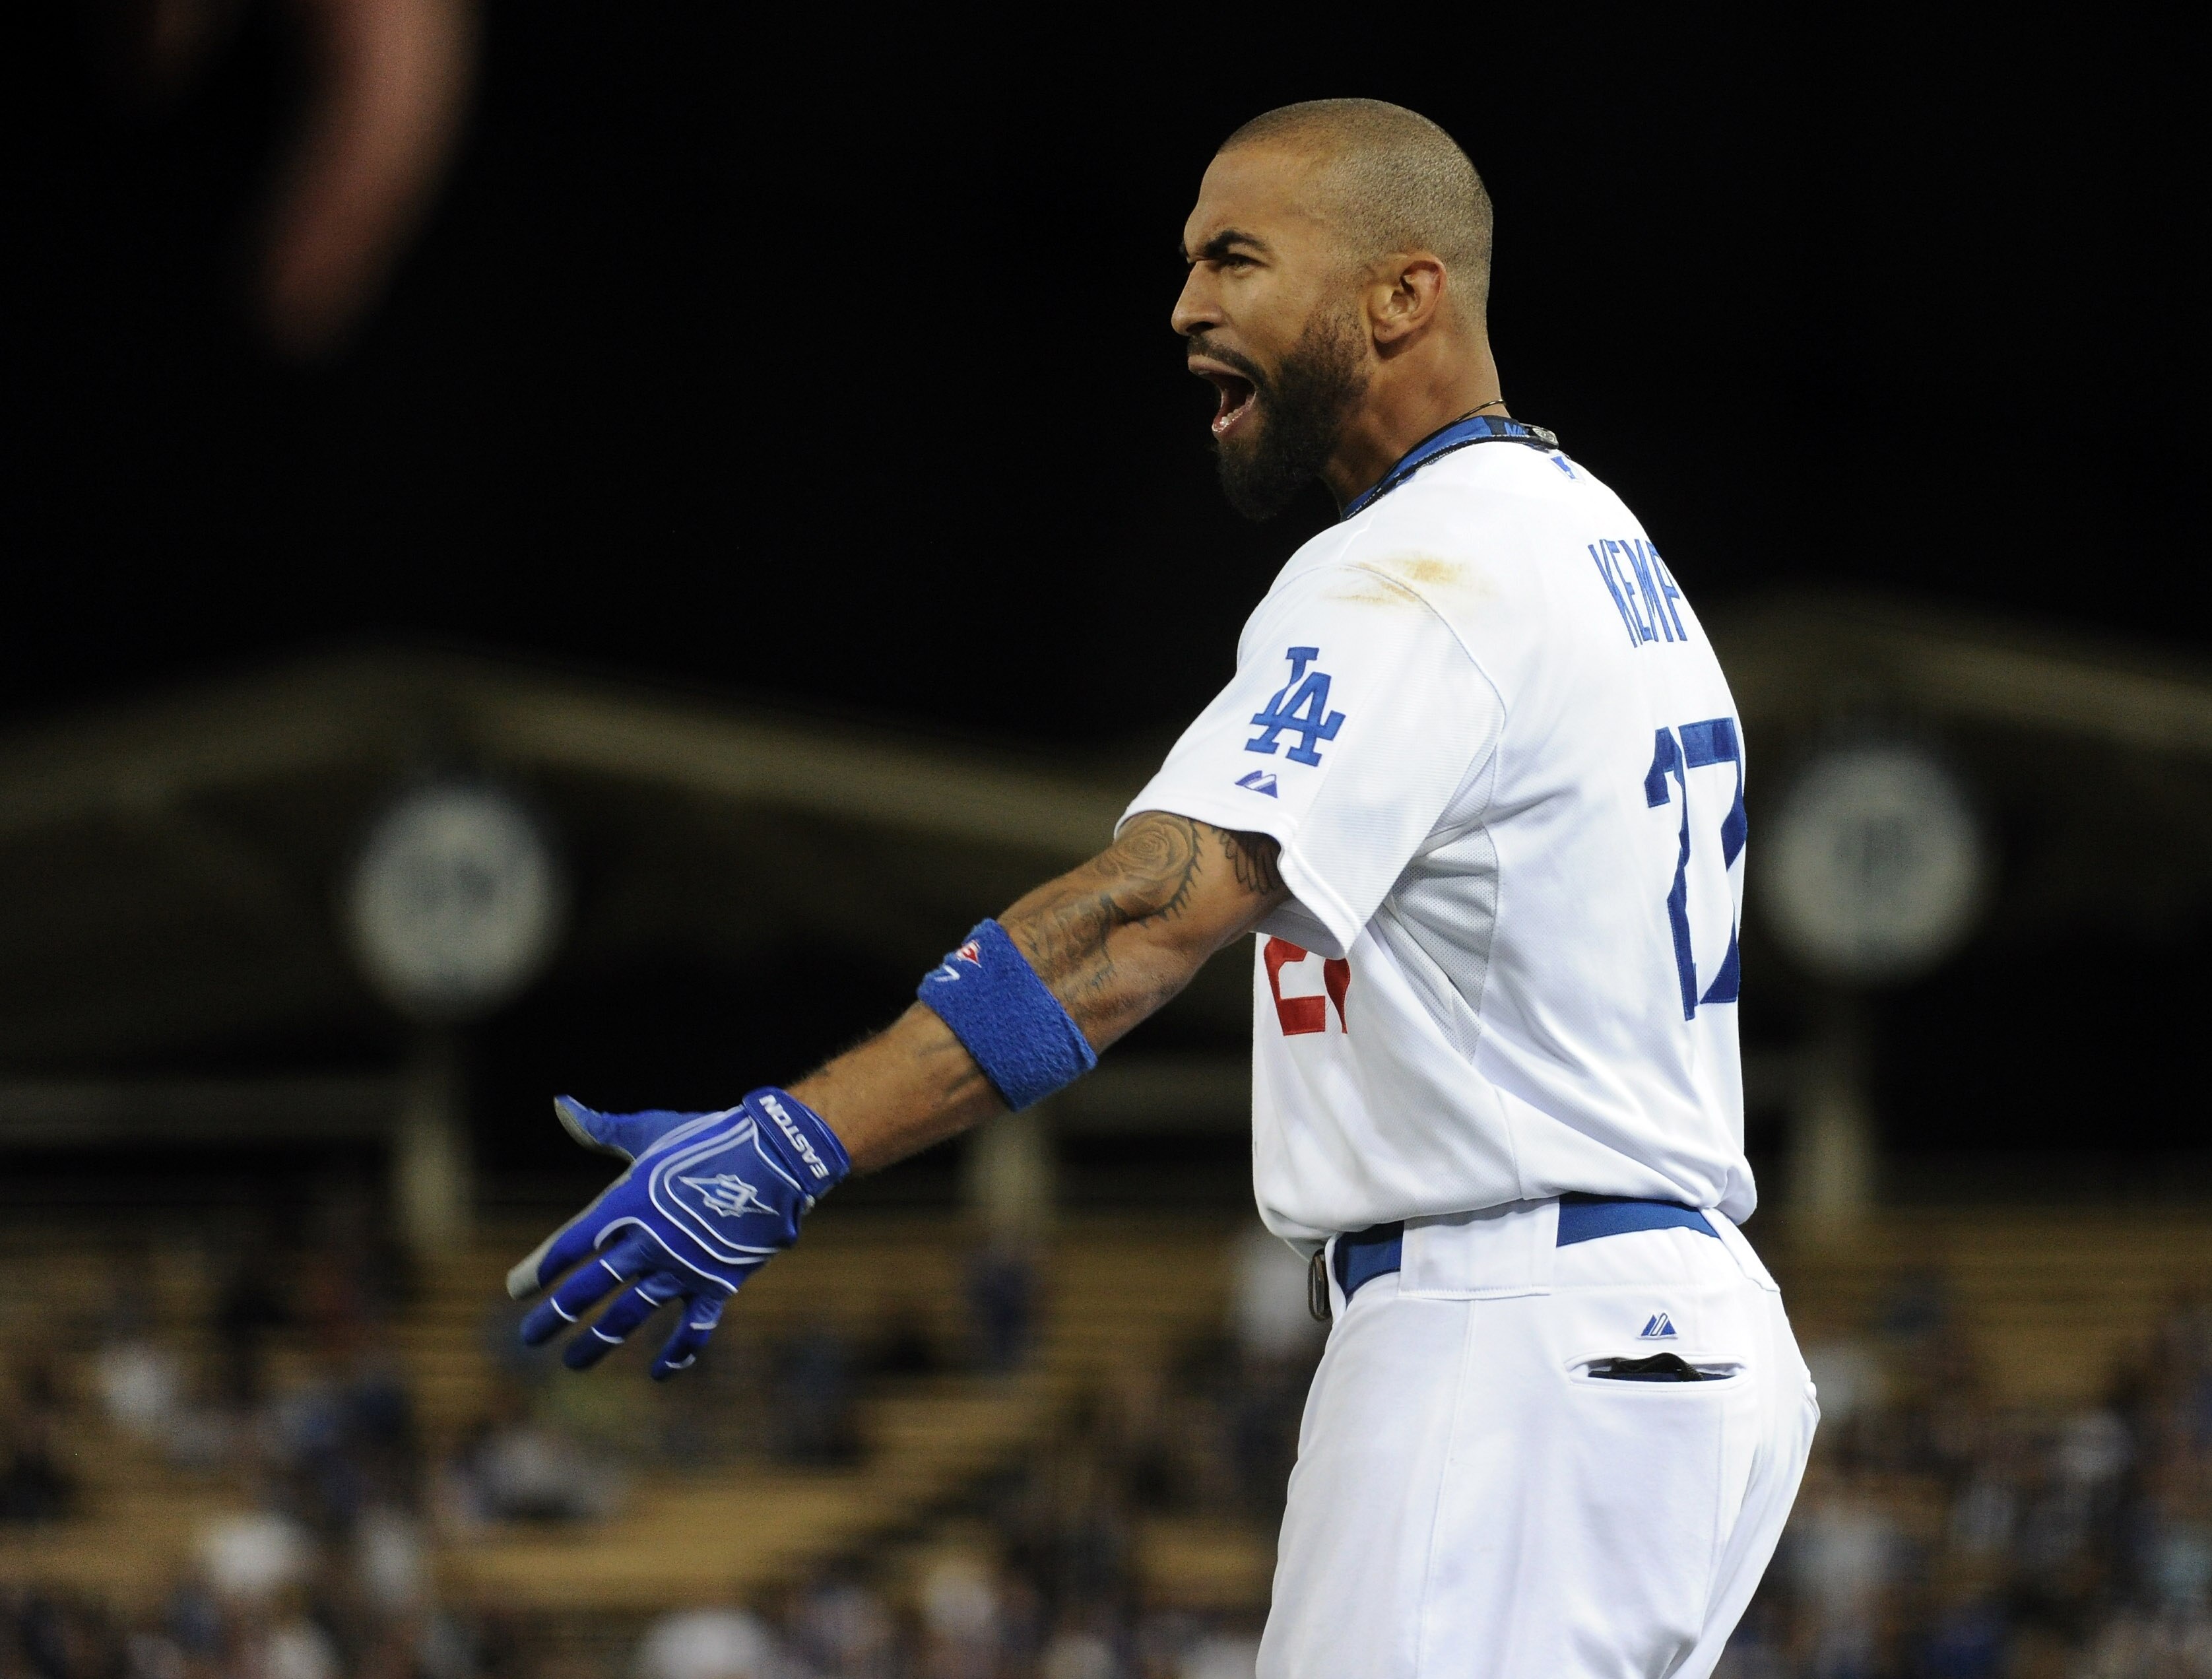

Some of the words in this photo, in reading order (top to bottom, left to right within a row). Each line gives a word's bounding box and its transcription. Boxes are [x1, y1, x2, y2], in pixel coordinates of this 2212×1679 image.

[1588, 539, 1687, 648] KEMP
[1245, 647, 1346, 767] LA
[759, 1094, 830, 1179] EASTON
